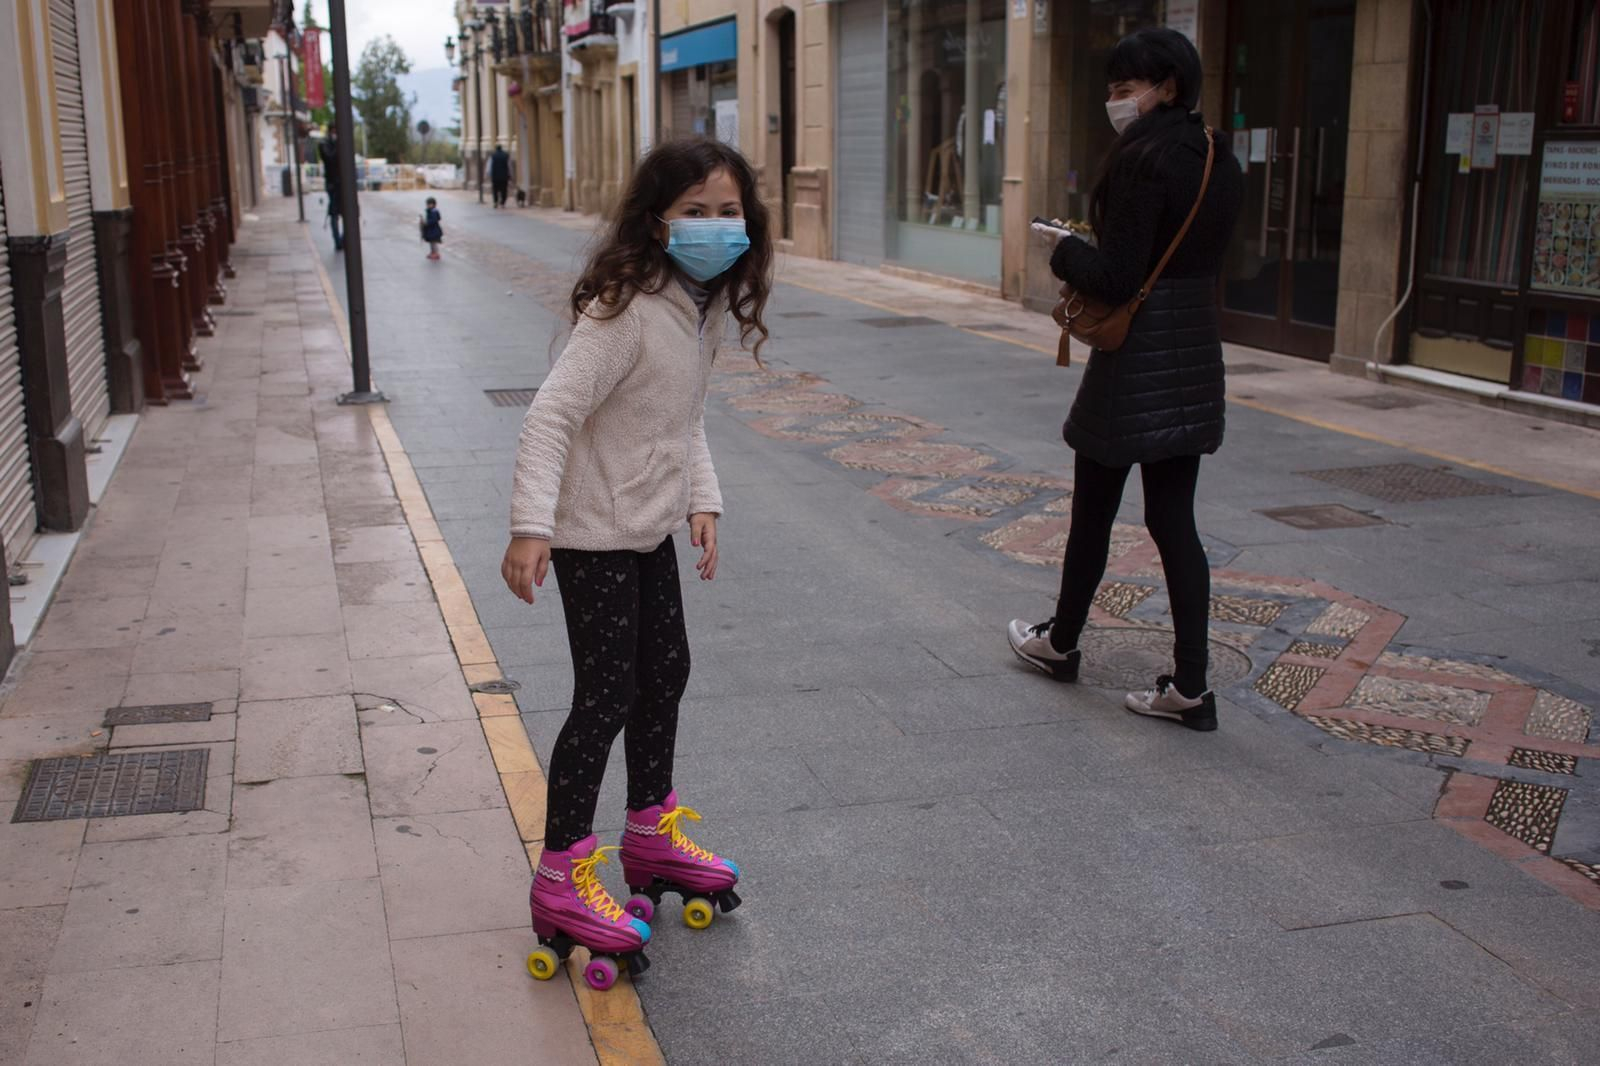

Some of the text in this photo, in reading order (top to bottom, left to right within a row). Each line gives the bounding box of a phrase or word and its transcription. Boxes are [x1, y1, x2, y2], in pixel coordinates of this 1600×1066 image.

[1544, 161, 1568, 169] VINOS
[1570, 161, 1579, 169] DE
[1543, 176, 1581, 184] MERIENDAS
